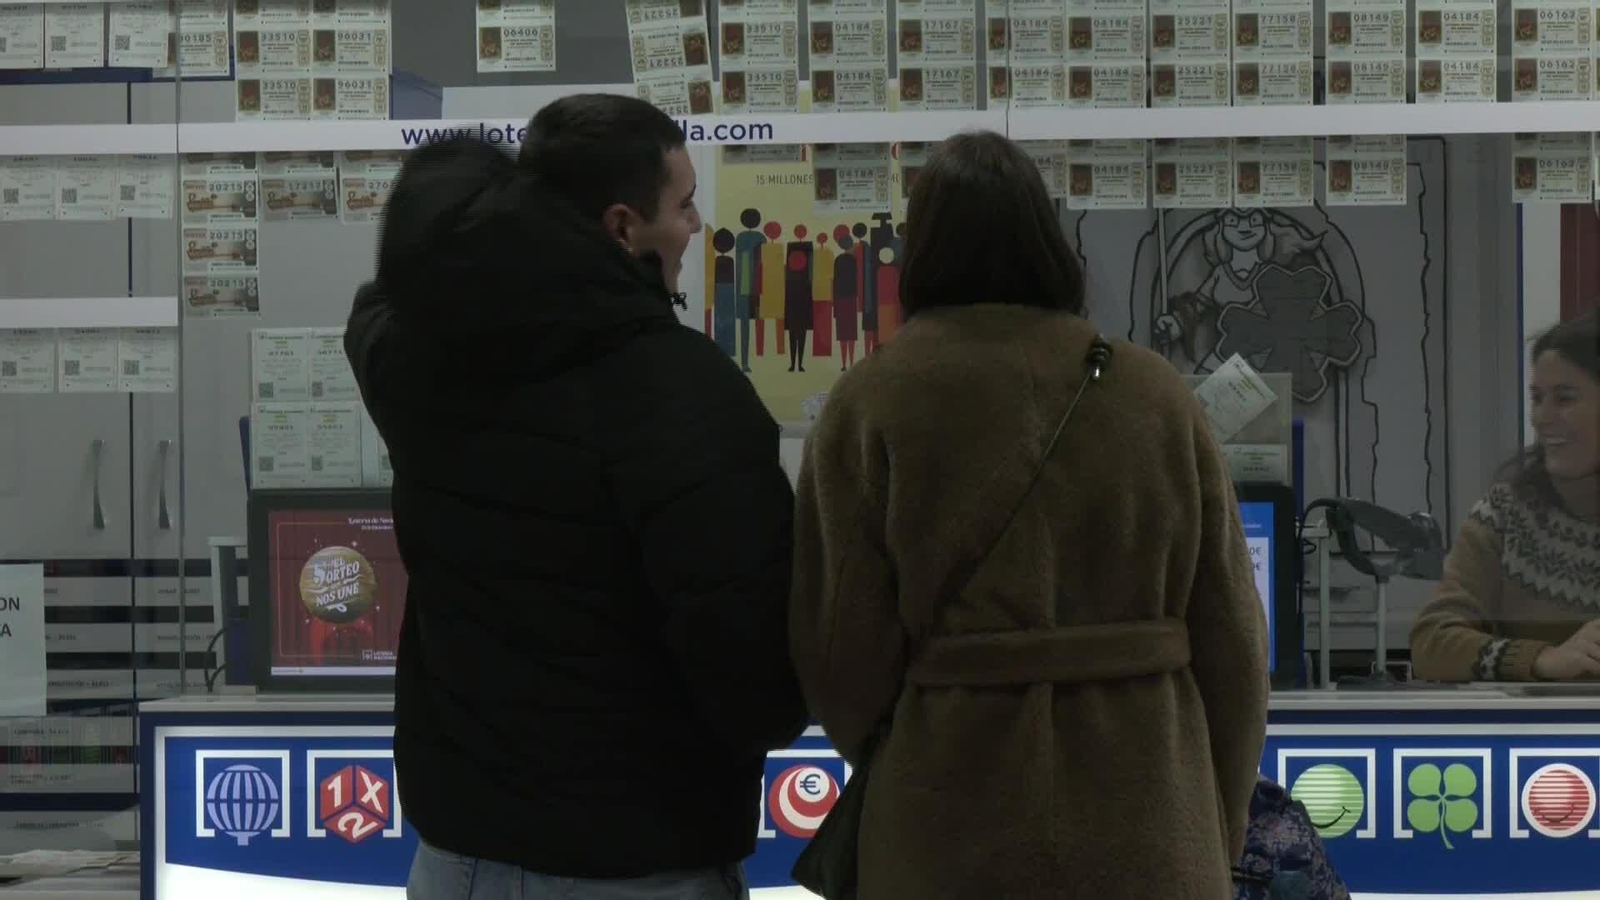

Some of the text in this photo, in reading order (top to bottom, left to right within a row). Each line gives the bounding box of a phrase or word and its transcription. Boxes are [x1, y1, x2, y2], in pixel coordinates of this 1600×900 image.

[1177, 17, 1213, 25] 25221
[1443, 12, 1480, 21] 04184
[835, 23, 870, 32] 04184
[1013, 19, 1048, 27] 04184
[1093, 19, 1128, 28] 04184
[261, 32, 295, 41] 33510
[503, 28, 538, 37] 06406
[1177, 66, 1213, 74] 25221
[1353, 63, 1389, 71] 08149
[1443, 61, 1480, 71] 04184
[836, 72, 871, 80] 04184
[926, 70, 959, 78] 17167
[1014, 68, 1049, 77] 04184
[1093, 68, 1129, 77] 04184
[747, 73, 781, 82] 33510
[262, 81, 296, 90] 33510
[1094, 165, 1129, 174] 04184
[756, 172, 813, 185] 15 MILLONES
[314, 560, 360, 587] SORTEO
[316, 581, 360, 607] NOS UNE
[327, 774, 342, 808] 1
[360, 770, 384, 814] X
